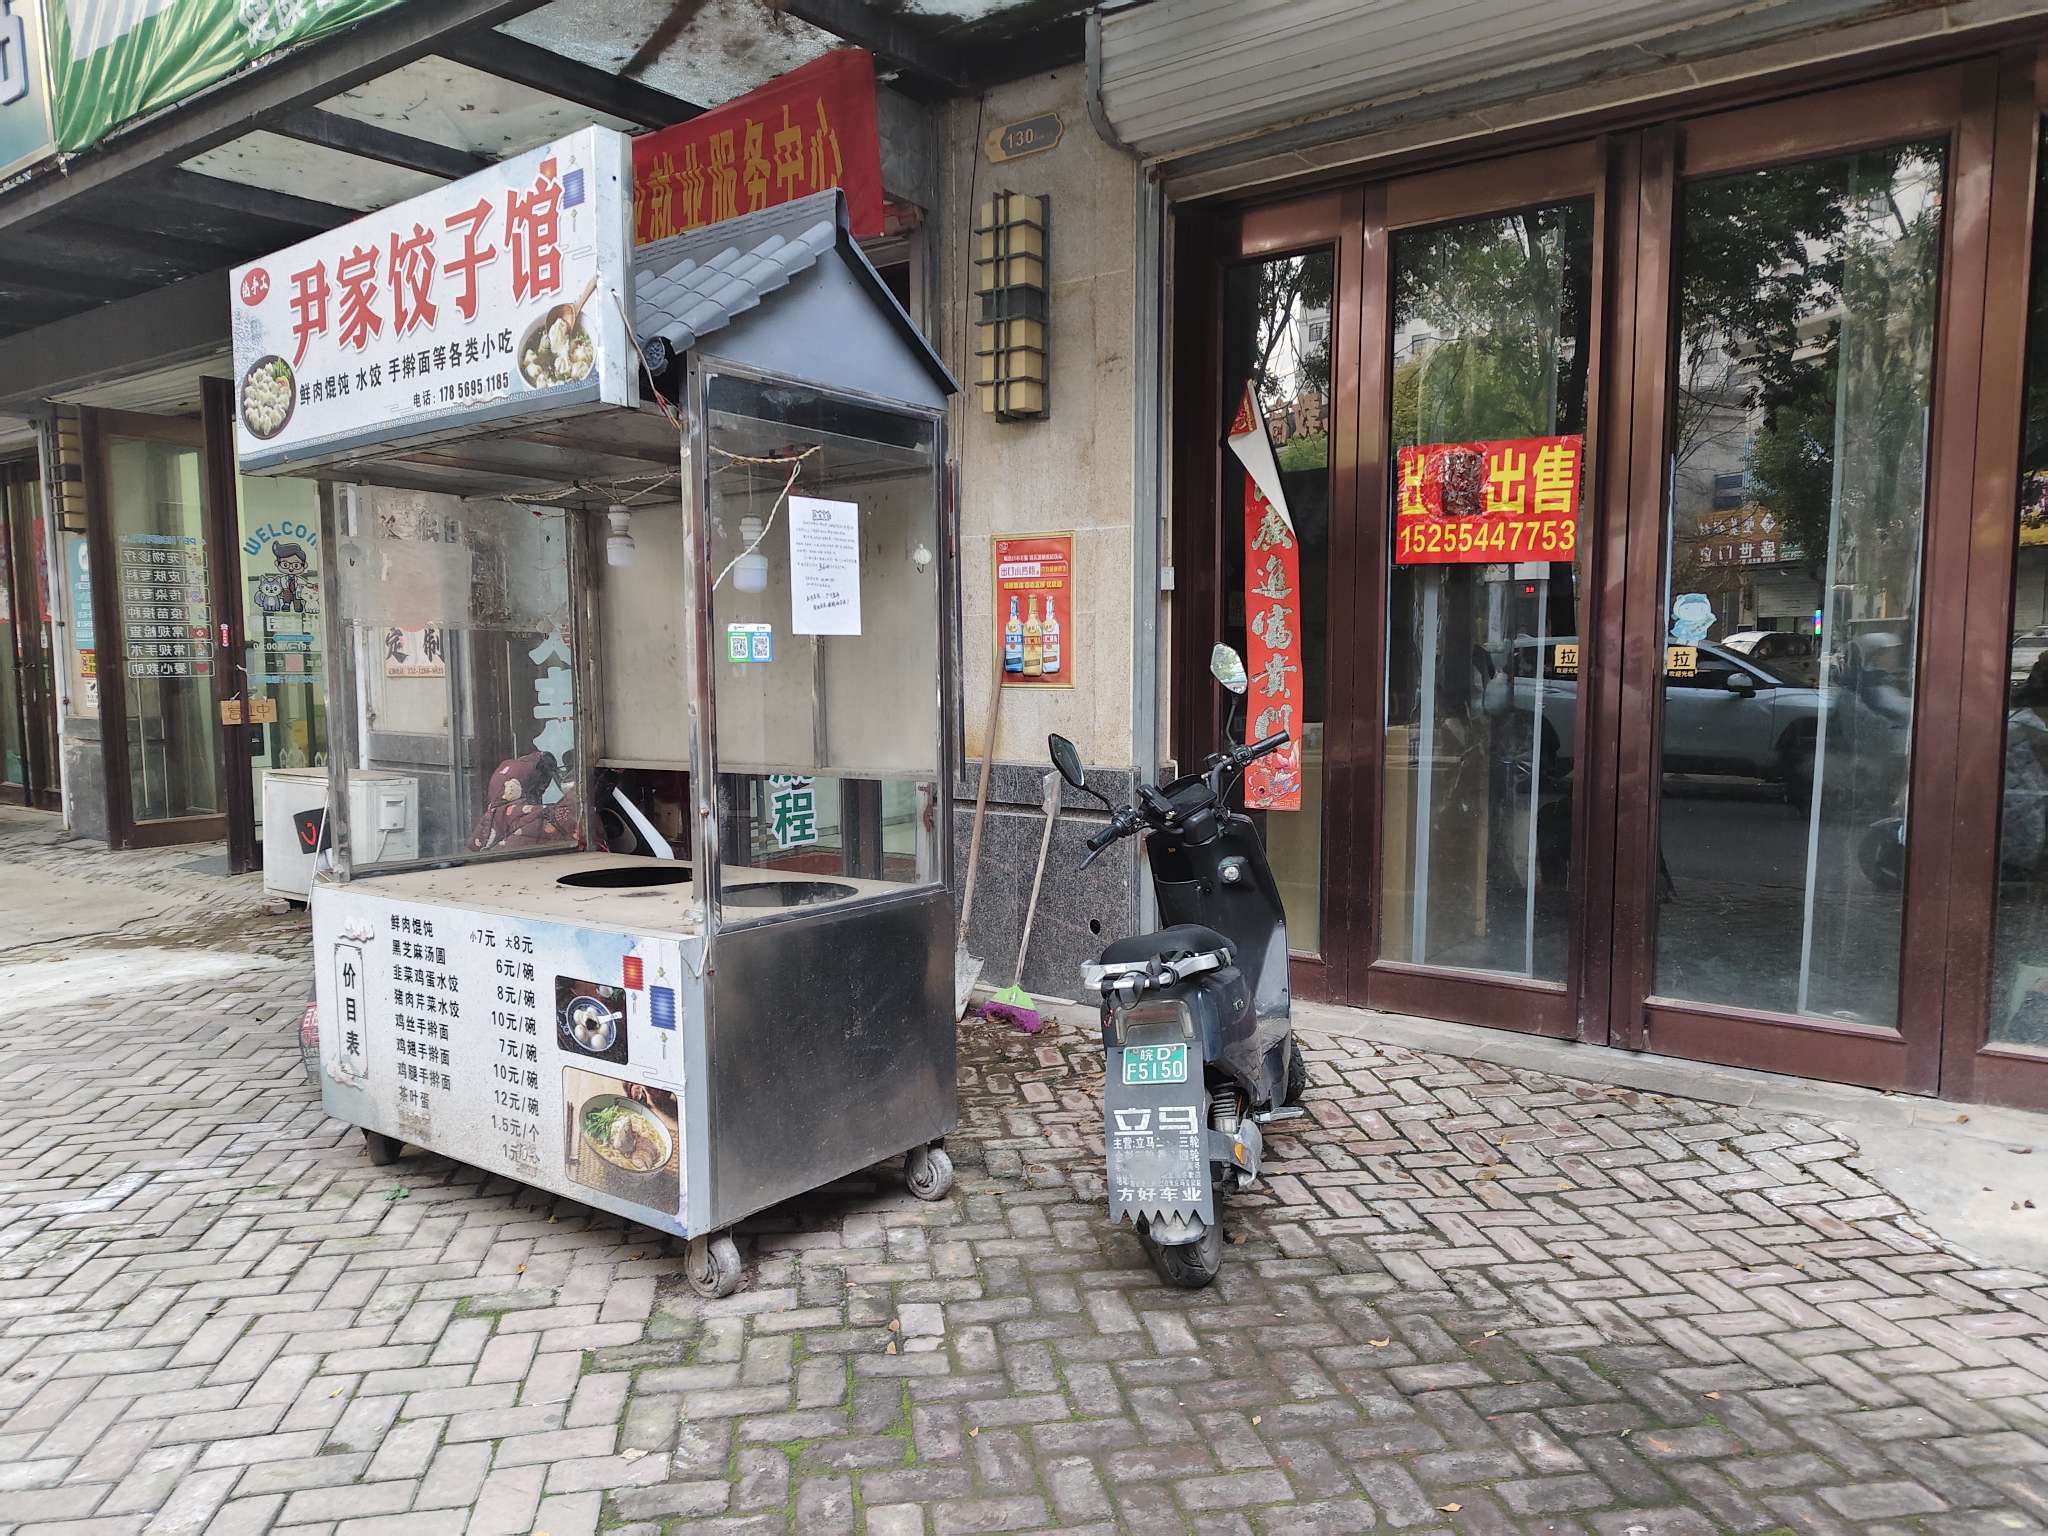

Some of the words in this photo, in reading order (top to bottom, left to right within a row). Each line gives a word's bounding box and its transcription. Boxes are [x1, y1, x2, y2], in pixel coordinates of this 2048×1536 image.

[1008, 128, 1034, 149] 130
[290, 177, 562, 368] 尹家饺子馆
[300, 372, 350, 406] 鲜肉馄饨
[356, 363, 382, 392] 水饺
[388, 328, 513, 383] 手擀面等各类小吃
[440, 385, 455, 402] 178
[458, 379, 483, 397] 5695
[486, 372, 509, 391] 1185
[1401, 445, 1576, 515] 出出售
[1400, 520, 1576, 555] 15255447753
[1561, 649, 1577, 665] 拉
[1673, 651, 1690, 667] 拉
[391, 914, 433, 938] 鲜肉馄饨
[392, 939, 446, 965] 黑芝麻汤圆
[496, 959, 535, 982] 6元/碗
[393, 964, 459, 993] 韭菜鸡蛋水饺
[497, 985, 536, 1009] 8元/碗
[343, 962, 360, 1057] 价目表
[394, 988, 460, 1018] 猪肉芹菜水饺
[491, 1010, 537, 1036] 10元/碗
[395, 1013, 449, 1042] 鸡丝手擀面
[499, 1038, 538, 1063] 7元/碗
[396, 1038, 450, 1067] 鸡翅手擀面
[493, 1063, 539, 1090] 10元/碗
[1126, 1060, 1183, 1081] F5150
[397, 1062, 451, 1092] 鸡腿手擀面
[494, 1089, 540, 1117] 12元/碗
[491, 1114, 540, 1142] 1.5元/个
[1113, 1106, 1199, 1135] 立马
[1117, 1187, 1203, 1202] 方好车业
